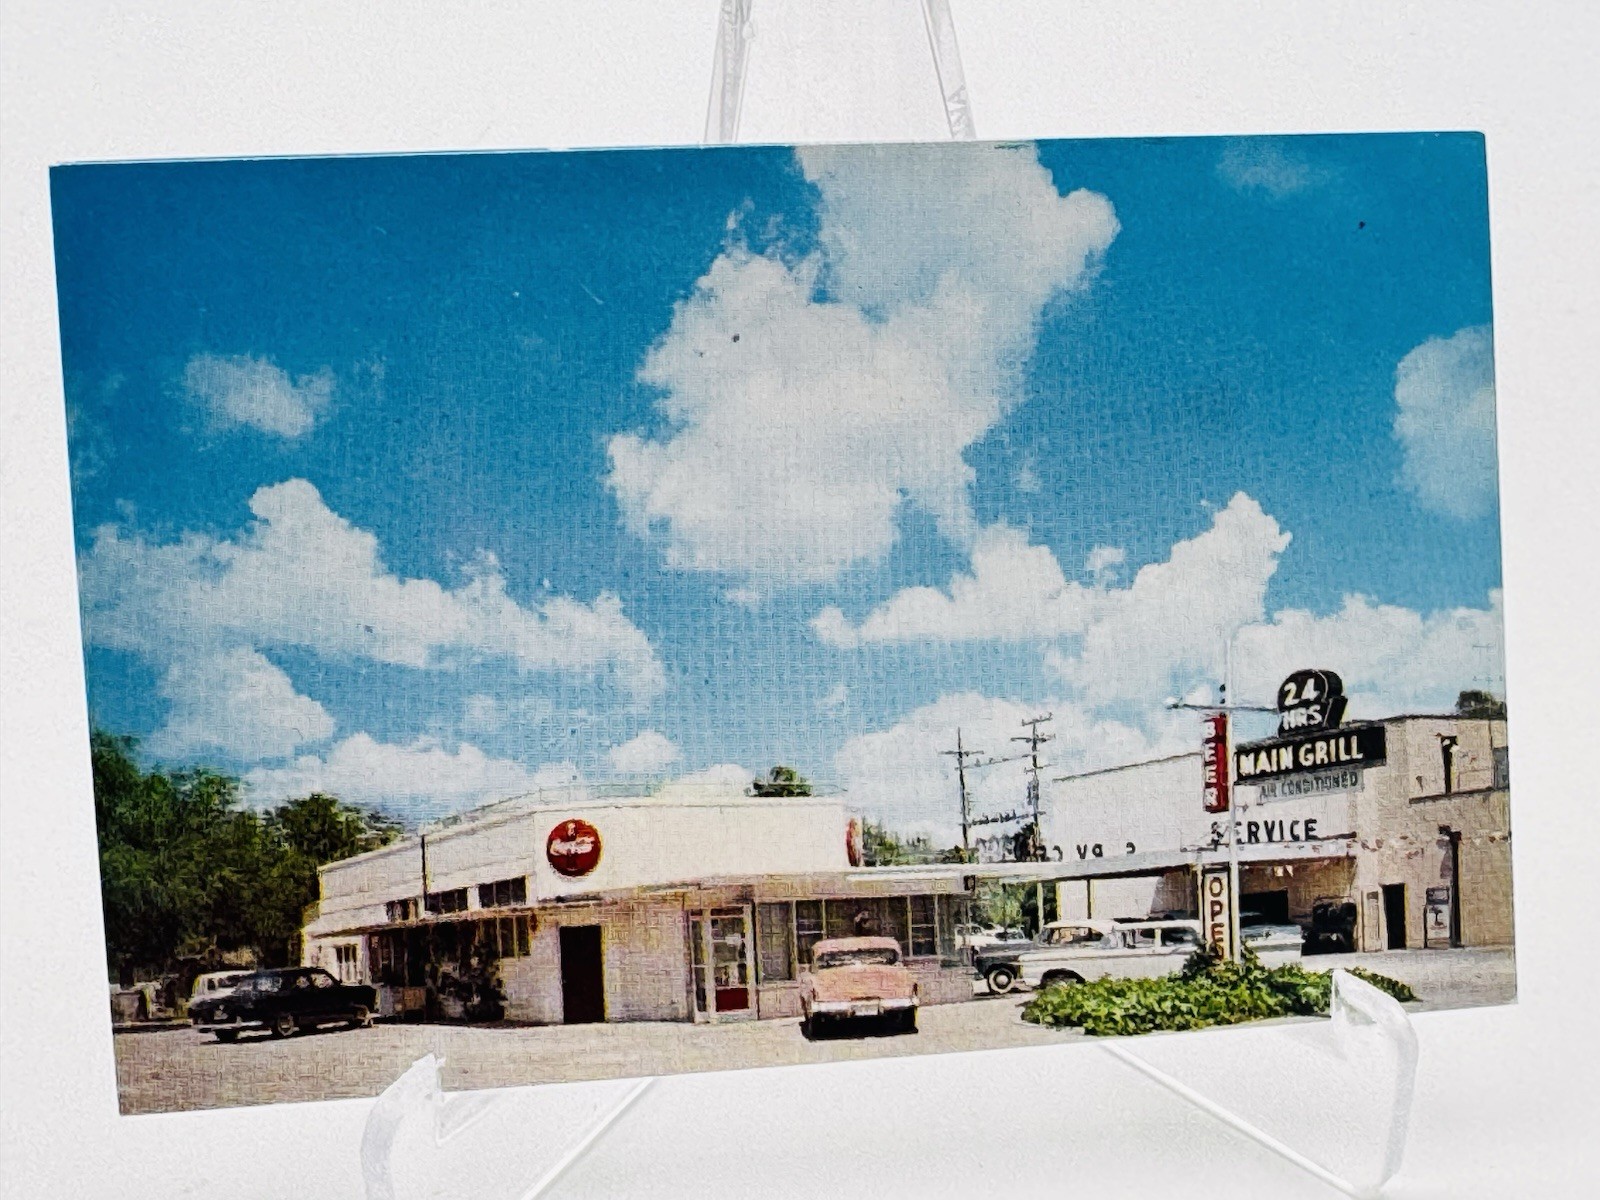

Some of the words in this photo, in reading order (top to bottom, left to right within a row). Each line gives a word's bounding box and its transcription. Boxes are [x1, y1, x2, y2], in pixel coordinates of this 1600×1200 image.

[1283, 678, 1321, 706] 24
[1202, 720, 1218, 807] BEER
[1239, 745, 1294, 777] MAIN
[1299, 735, 1364, 767] GRILL
